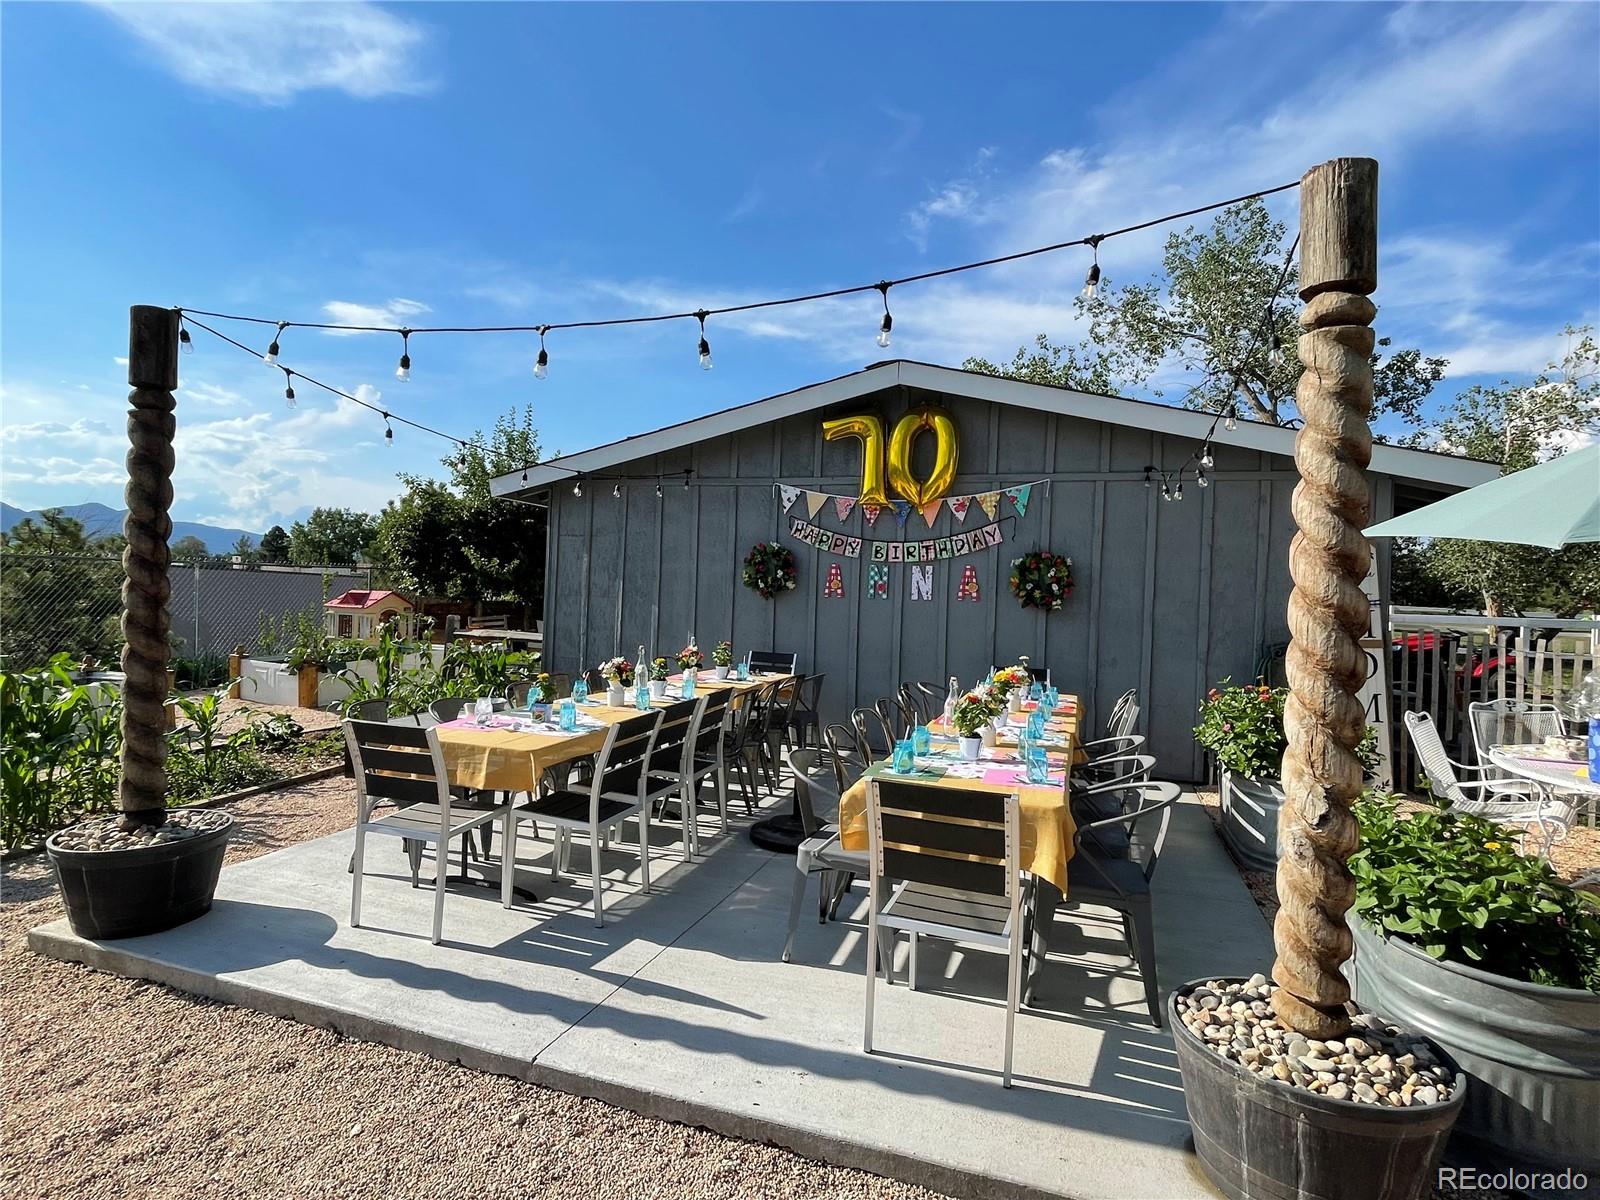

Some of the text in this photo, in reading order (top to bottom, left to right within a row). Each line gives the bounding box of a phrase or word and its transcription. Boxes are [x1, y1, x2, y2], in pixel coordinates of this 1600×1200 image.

[822, 407, 959, 508] 70
[793, 521, 997, 560] HAPPY BIRTHDAY
[824, 563, 981, 602] ANNA
